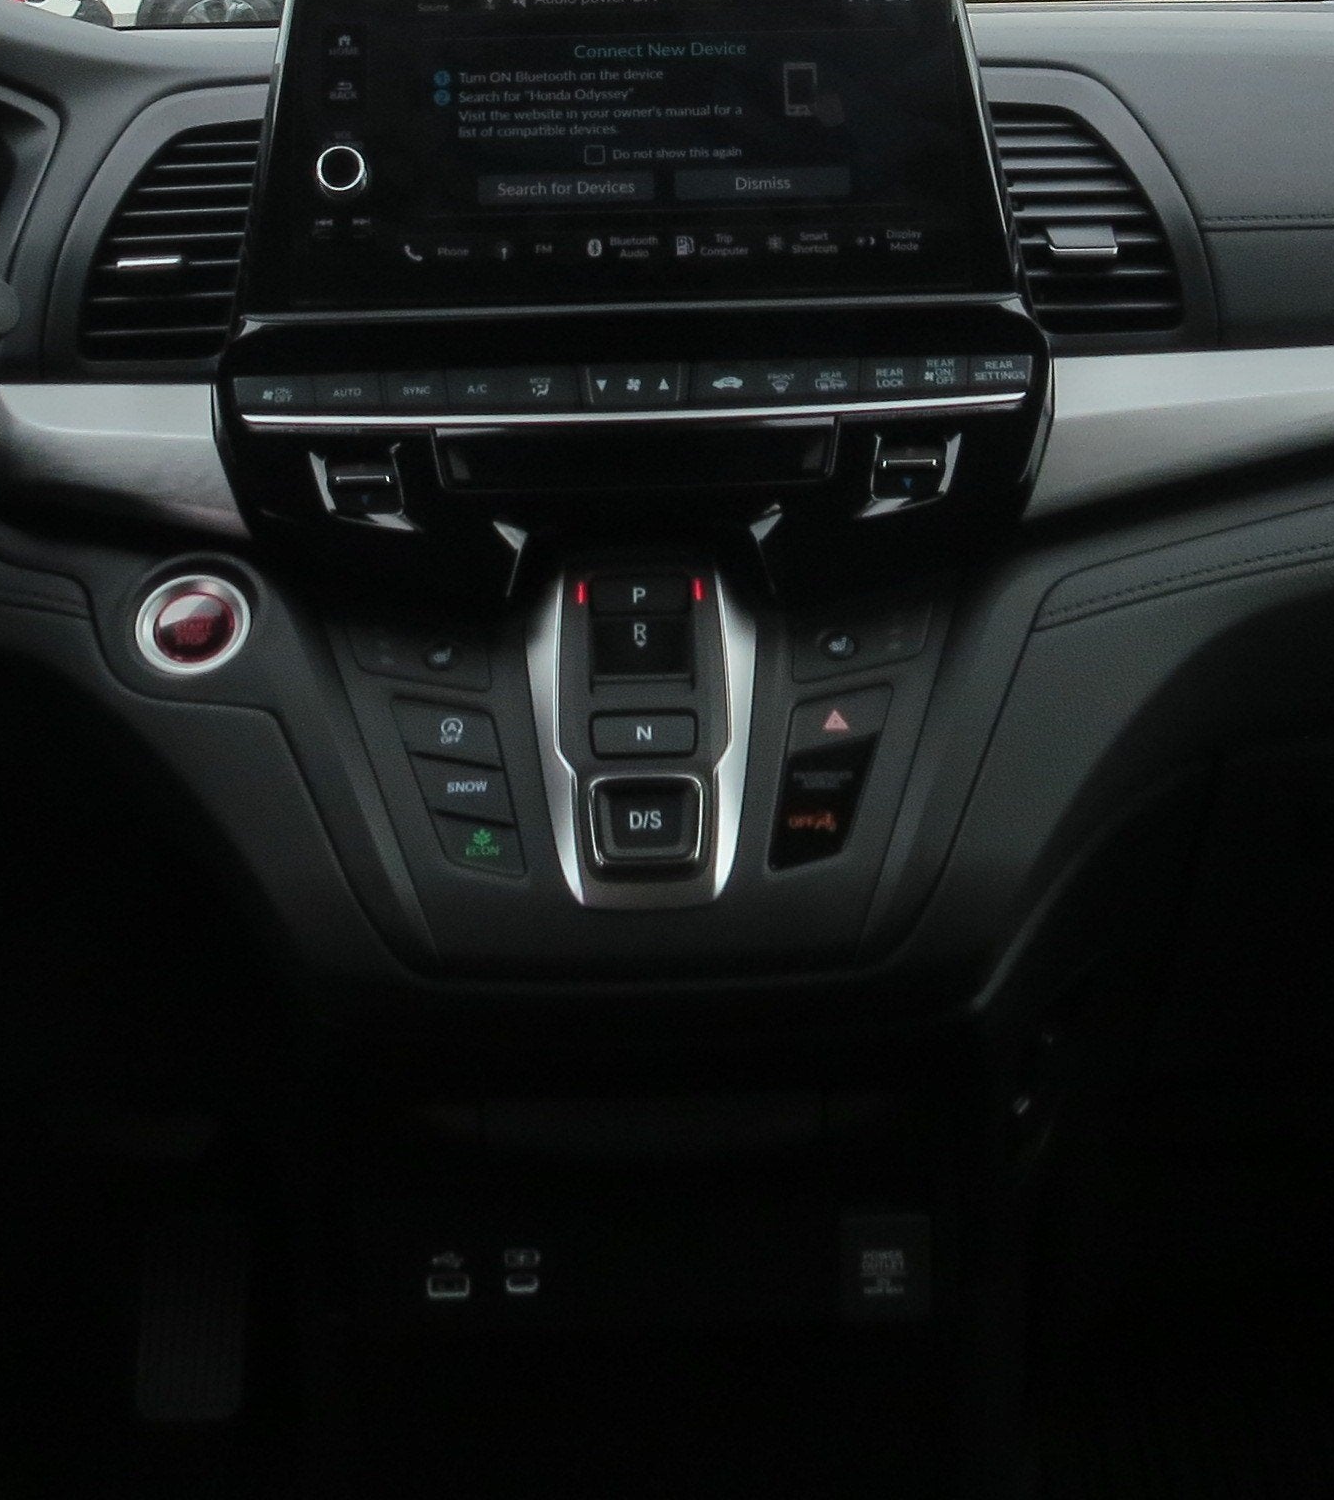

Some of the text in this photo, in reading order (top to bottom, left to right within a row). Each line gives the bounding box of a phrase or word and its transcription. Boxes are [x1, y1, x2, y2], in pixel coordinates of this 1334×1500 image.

[573, 40, 747, 60] Connect New Device
[458, 68, 664, 84] Turn ON Bluetooth on the device
[458, 91, 500, 103] Search
[503, 90, 521, 102] for
[458, 110, 487, 123] Visit
[490, 109, 510, 121] the
[513, 108, 562, 120] website
[581, 108, 609, 122] your
[665, 105, 711, 117] manual
[714, 104, 732, 116] for
[497, 123, 566, 139] compatible
[612, 146, 743, 160] Do not show this again
[497, 179, 636, 197] Search for Devices
[734, 176, 792, 192] Dismiss
[875, 367, 904, 378] REAR
[984, 360, 1013, 370] REAR
[973, 370, 1027, 382] SETTINGS
[333, 386, 362, 398] AUTO
[402, 385, 431, 396] SYNC
[467, 384, 488, 395] A/C
[632, 586, 646, 604] P
[633, 623, 647, 642] R
[636, 725, 652, 741] N
[447, 780, 488, 793] SNOW
[628, 810, 662, 830] D/S
[465, 845, 501, 857] ECON
